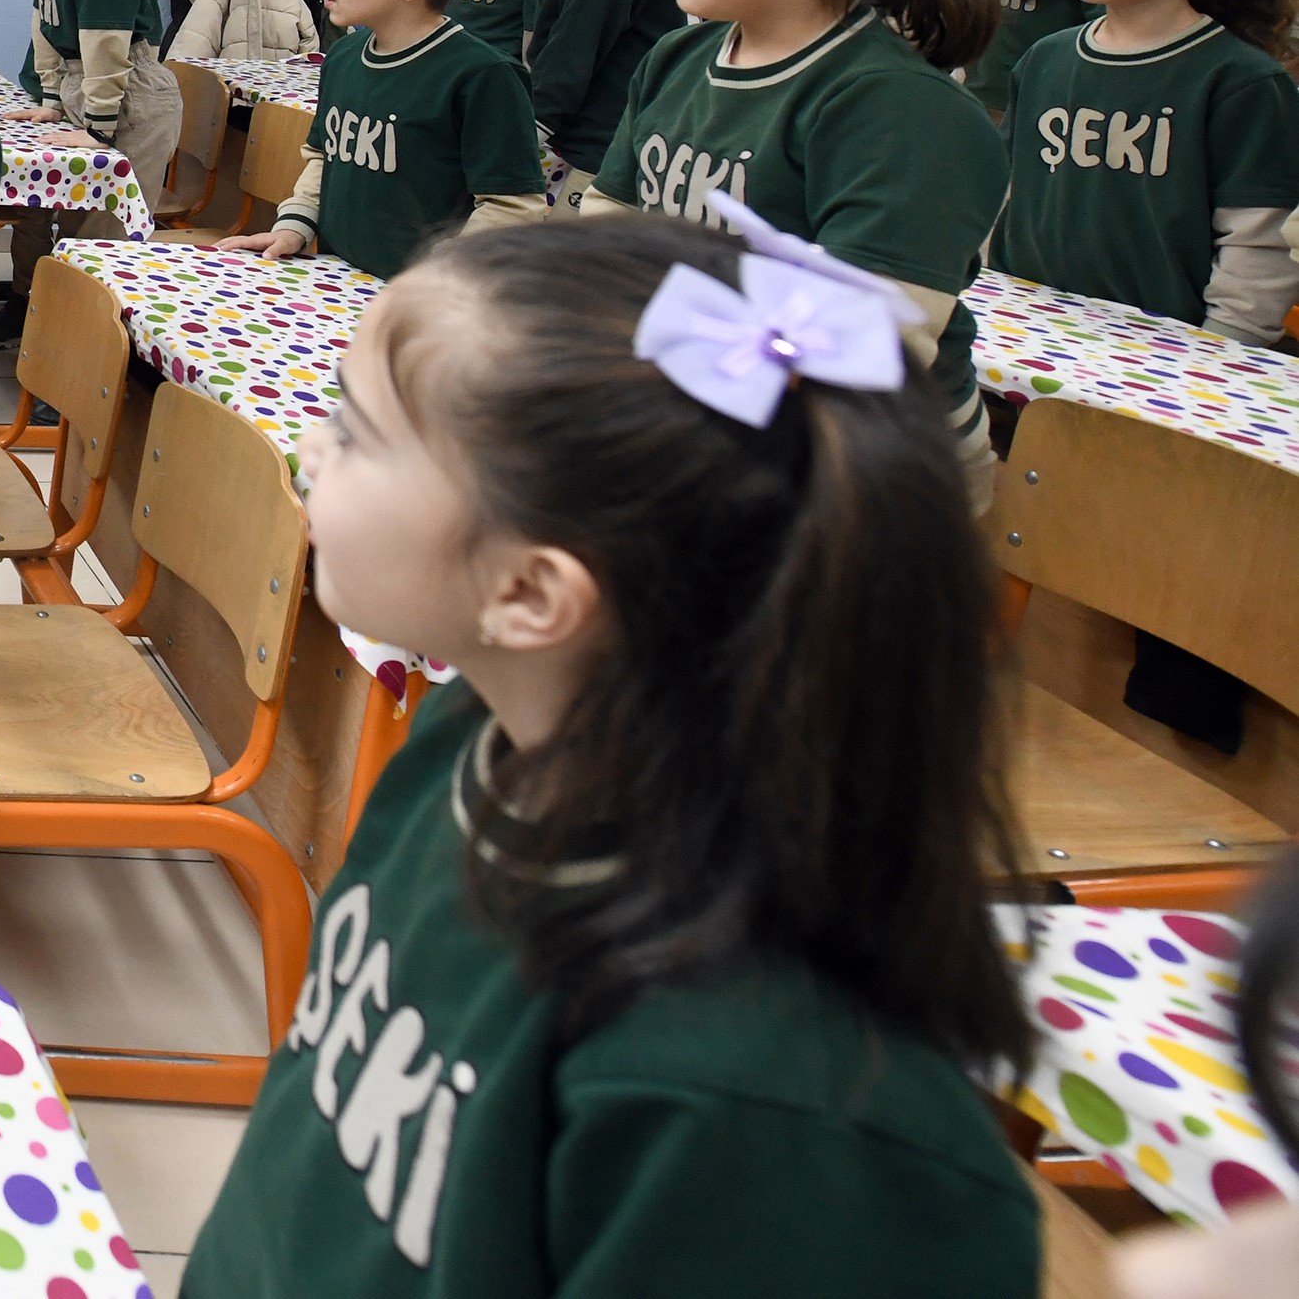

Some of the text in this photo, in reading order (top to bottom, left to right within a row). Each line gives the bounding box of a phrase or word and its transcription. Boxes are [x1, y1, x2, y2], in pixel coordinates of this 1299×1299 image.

[325, 105, 398, 173] ŞEKİ
[1038, 106, 1174, 177] ŞEKİ
[640, 134, 753, 236] ŞEKİ
[288, 883, 478, 1269] ŞEKİ
